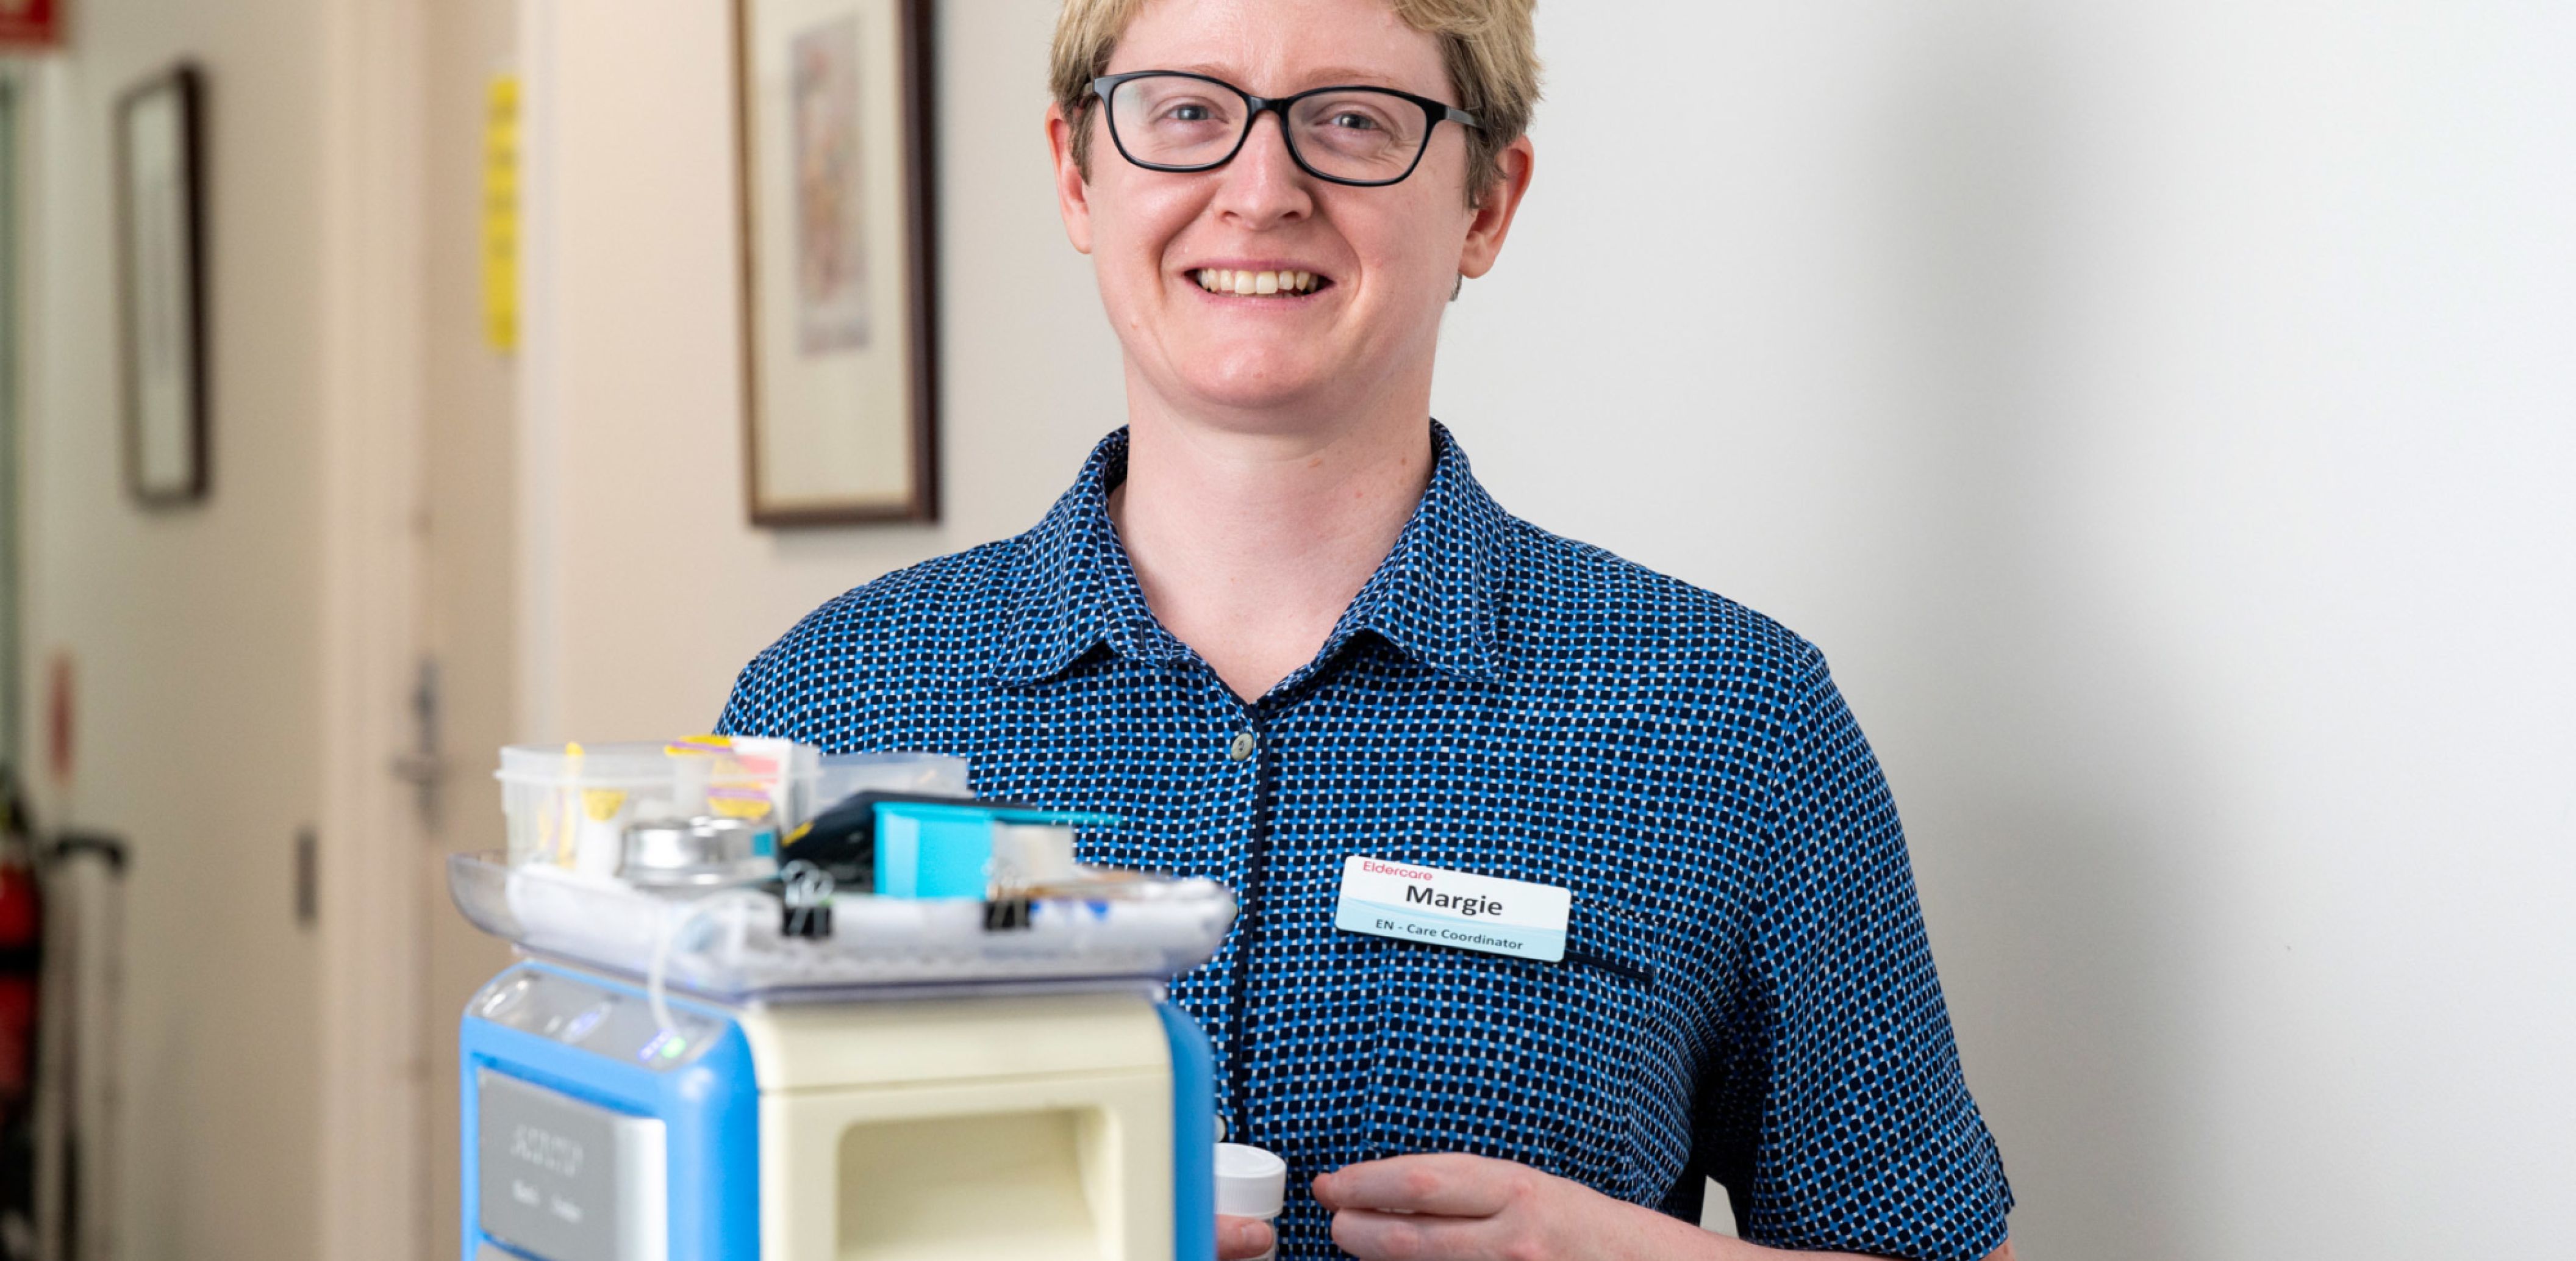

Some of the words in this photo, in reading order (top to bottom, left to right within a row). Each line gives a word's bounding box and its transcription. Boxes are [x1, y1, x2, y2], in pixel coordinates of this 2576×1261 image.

[1362, 861, 1433, 881] Eldercare
[1406, 885, 1503, 916] Margie
[1375, 919, 1395, 930] EN
[1407, 924, 1437, 937] Care
[1441, 929, 1523, 950] Coordinator
